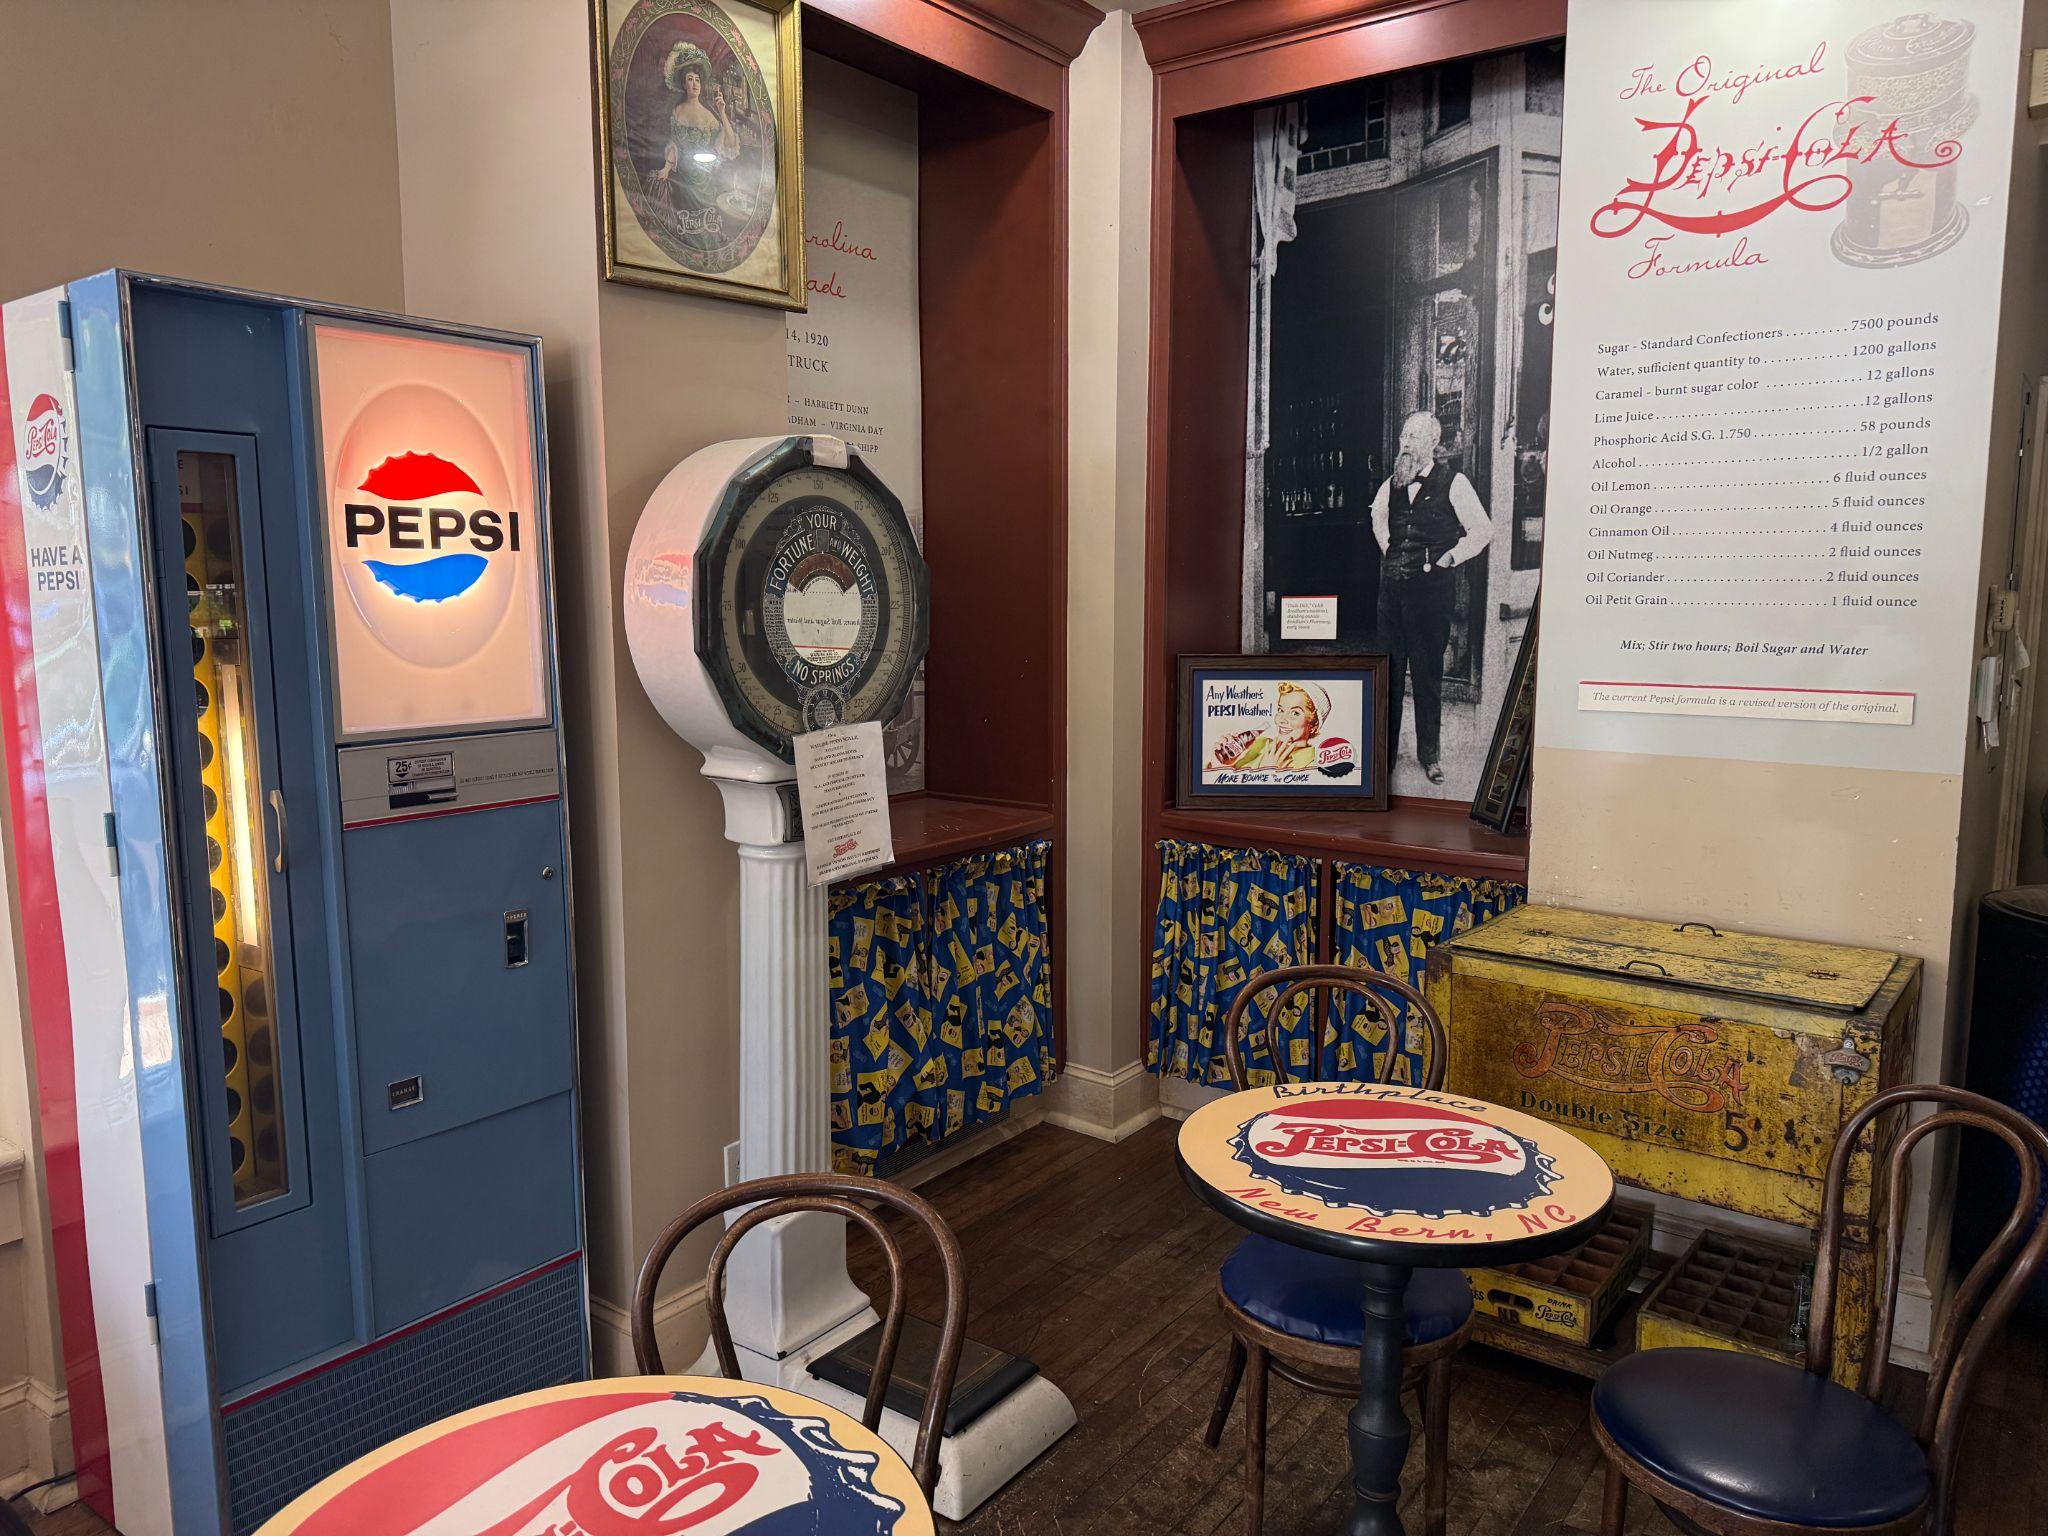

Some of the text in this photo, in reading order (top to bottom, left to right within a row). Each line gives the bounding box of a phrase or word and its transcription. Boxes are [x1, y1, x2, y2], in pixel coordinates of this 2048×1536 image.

[1619, 41, 1826, 104] The Original
[805, 221, 877, 260] rolina
[1627, 234, 1769, 279] Formula
[806, 272, 846, 298] ade
[805, 331, 829, 347] 1920
[1598, 312, 1938, 356] Sugar Standard Confectioners 7500 pounds
[787, 354, 829, 373] TRUCK
[1598, 338, 1936, 376] Water, sufficient quantity to 1200 gallons
[1596, 366, 1934, 400] Caramel burnt sugar color 12 gallons
[804, 398, 869, 415] HARRIETT DUNN
[1595, 392, 1932, 423] Lime Juice 12 gallons
[830, 420, 866, 433] VIRGINIA
[868, 426, 884, 436] DAY
[1594, 417, 1930, 448] Phosphoric Acid S.G. 1.750 58 pounds
[1592, 443, 1928, 469] Alcohol 1/2 gallon
[1591, 470, 1926, 494] Oil Lemon 6 fluid ounces
[1590, 496, 1925, 518] Oil Orange 5 fluid ounces
[345, 504, 521, 552] PEPSI
[806, 513, 837, 531] YOUR
[1589, 521, 1925, 537] Cinnamon Oil 4 fluid ounces
[31, 545, 83, 567] HAVE A
[770, 533, 816, 592] FORTUNE
[840, 540, 875, 595] WEIGHT
[1588, 550, 1604, 559] Oil
[1608, 550, 1653, 562] Nutmeg
[1829, 548, 1836, 557] 2
[1840, 546, 1870, 557] fluid
[37, 570, 80, 591] PEPSI
[1587, 571, 1919, 583] Oil Coriander 2 fluid ounces
[1586, 595, 1602, 604] Oil
[1606, 595, 1632, 604] Petit
[1635, 595, 1667, 605] Grain
[1833, 596, 1836, 606] 1
[1843, 595, 1872, 606] fluid
[1620, 640, 1869, 656] Mix; Stir two hours; Boil Sugar and Water
[793, 658, 855, 685] NO SPRINGS
[1206, 685, 1263, 702] Any Weather's
[1593, 692, 1609, 701] The
[1612, 694, 1647, 702] current
[1650, 694, 1675, 705] Pepsi
[1674, 694, 1716, 706] formula
[1719, 696, 1727, 705] is
[1738, 698, 1775, 708] revised
[1778, 700, 1816, 710] version
[1818, 700, 1830, 712] of
[1832, 701, 1848, 711] the
[1851, 702, 1899, 714] original.
[1208, 704, 1272, 717] PEPSI Weather!
[395, 761, 412, 773] 25¢
[1214, 774, 1238, 784] MORE
[1284, 774, 1309, 784] OUNCE
[1273, 1083, 1486, 1113] Birthplace
[1521, 1089, 1686, 1142] Double Size
[1225, 1187, 1577, 1241] New Bern, NC
[1547, 1298, 1573, 1309] DRINK
